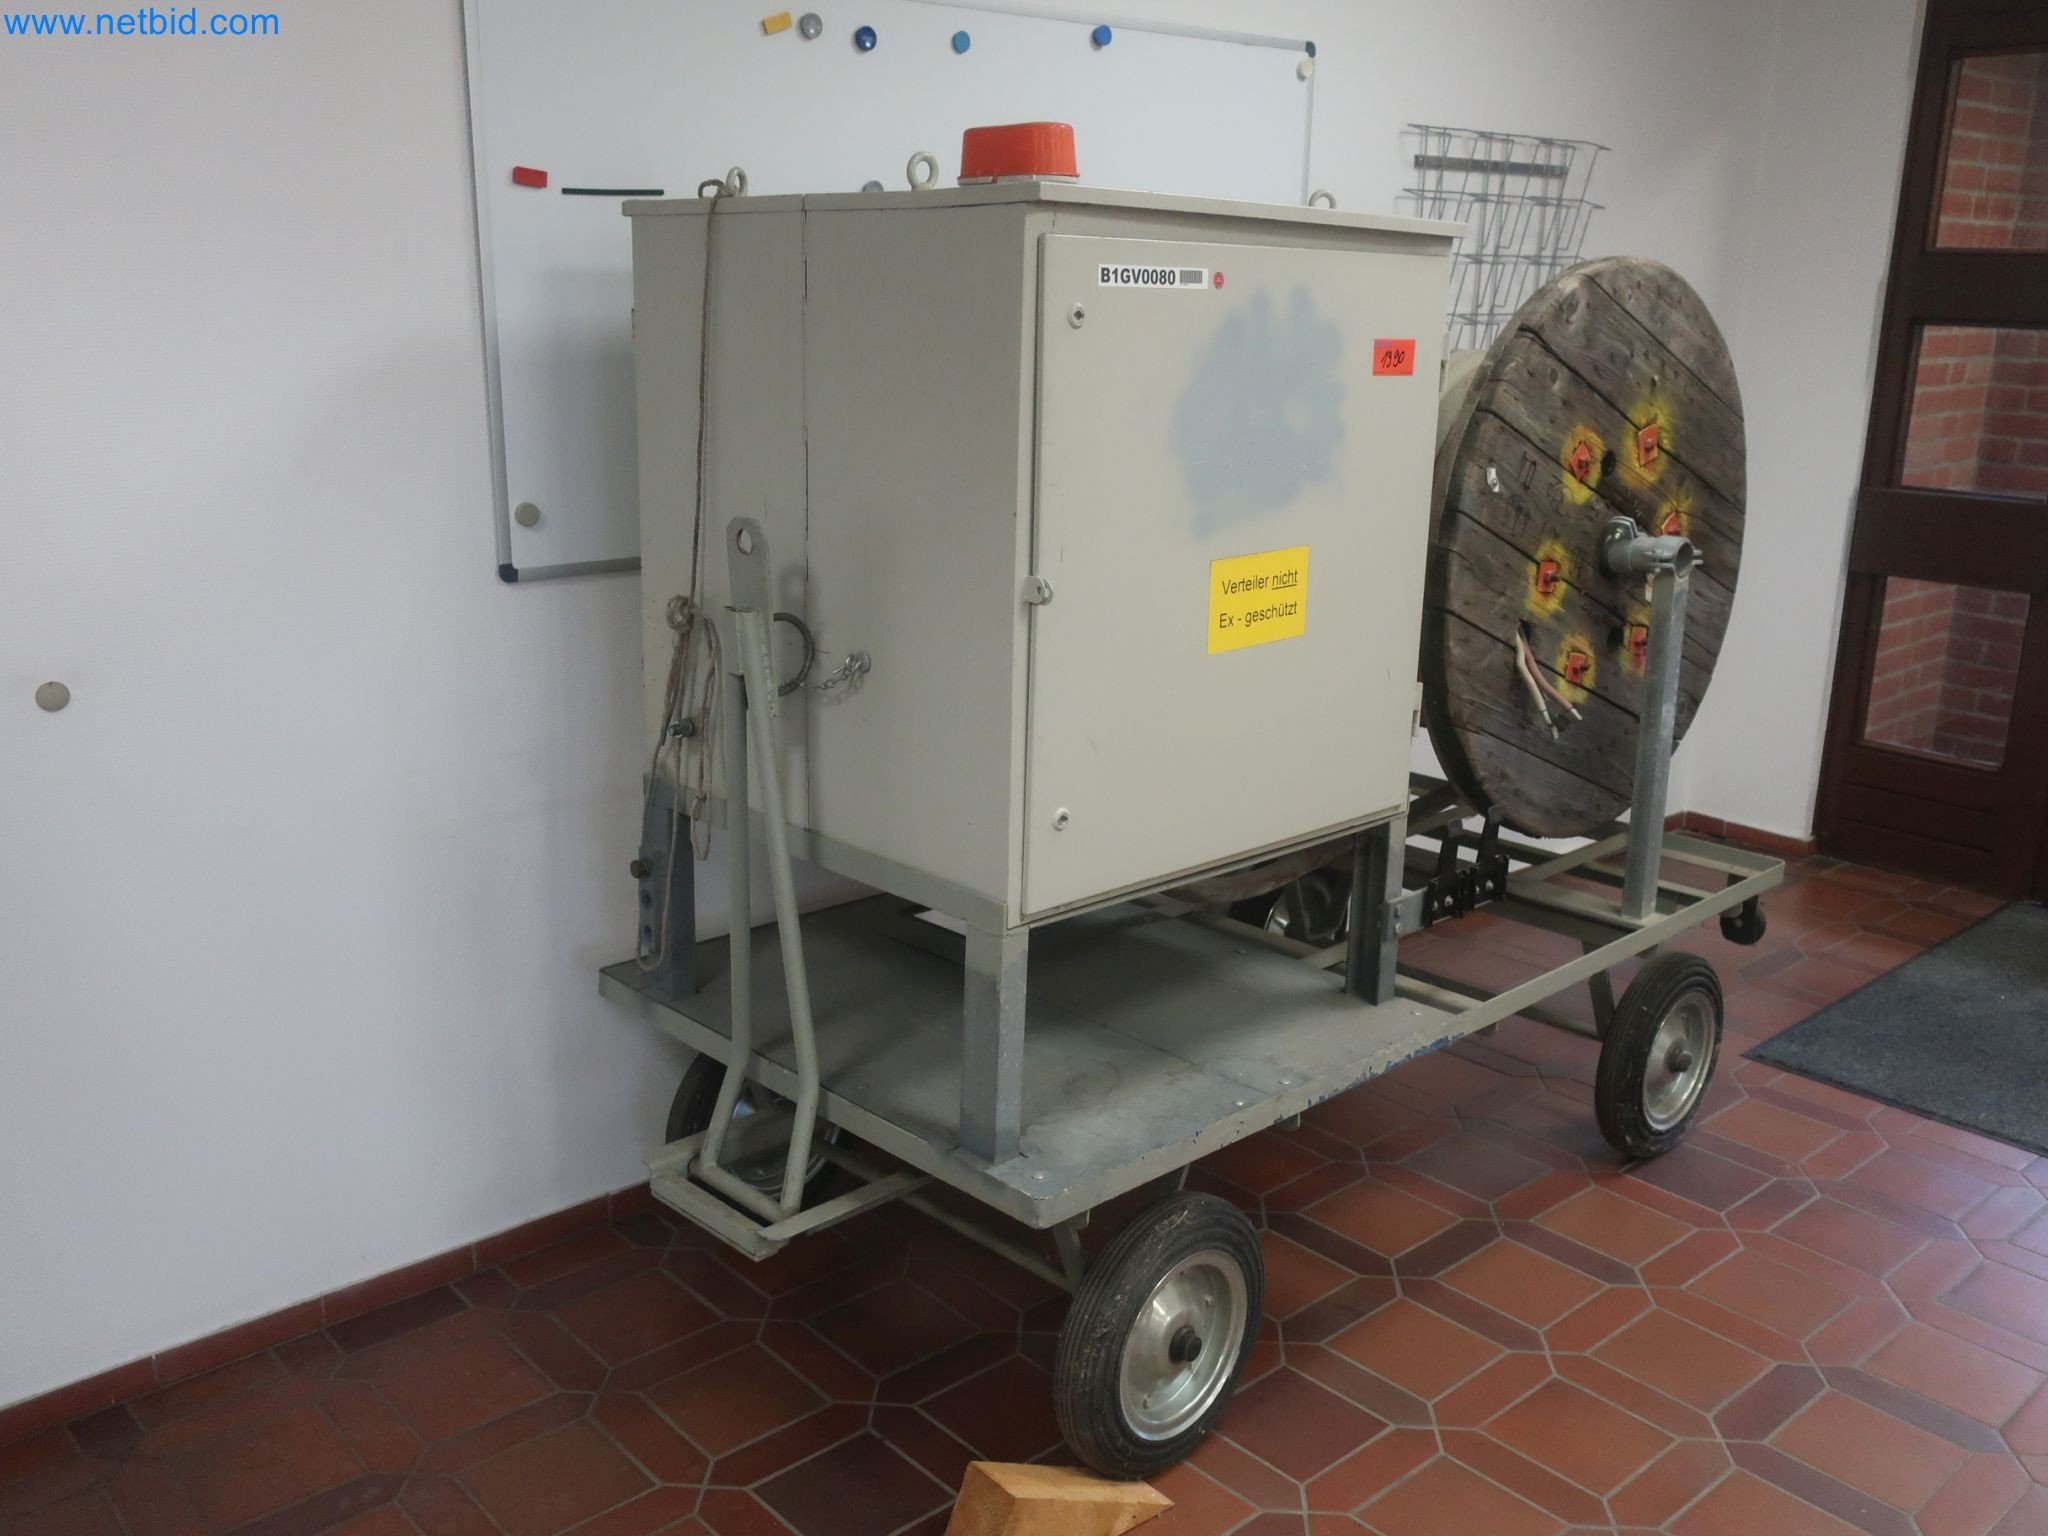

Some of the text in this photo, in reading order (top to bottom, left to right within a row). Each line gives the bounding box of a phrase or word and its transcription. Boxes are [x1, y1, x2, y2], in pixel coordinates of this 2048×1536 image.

[1100, 267, 1176, 285] B1GV0080
[1380, 349, 1405, 368] 1990
[1222, 569, 1298, 595] Verteiler nicht
[1219, 612, 1234, 628] Ex
[1244, 600, 1298, 627] geschützt
